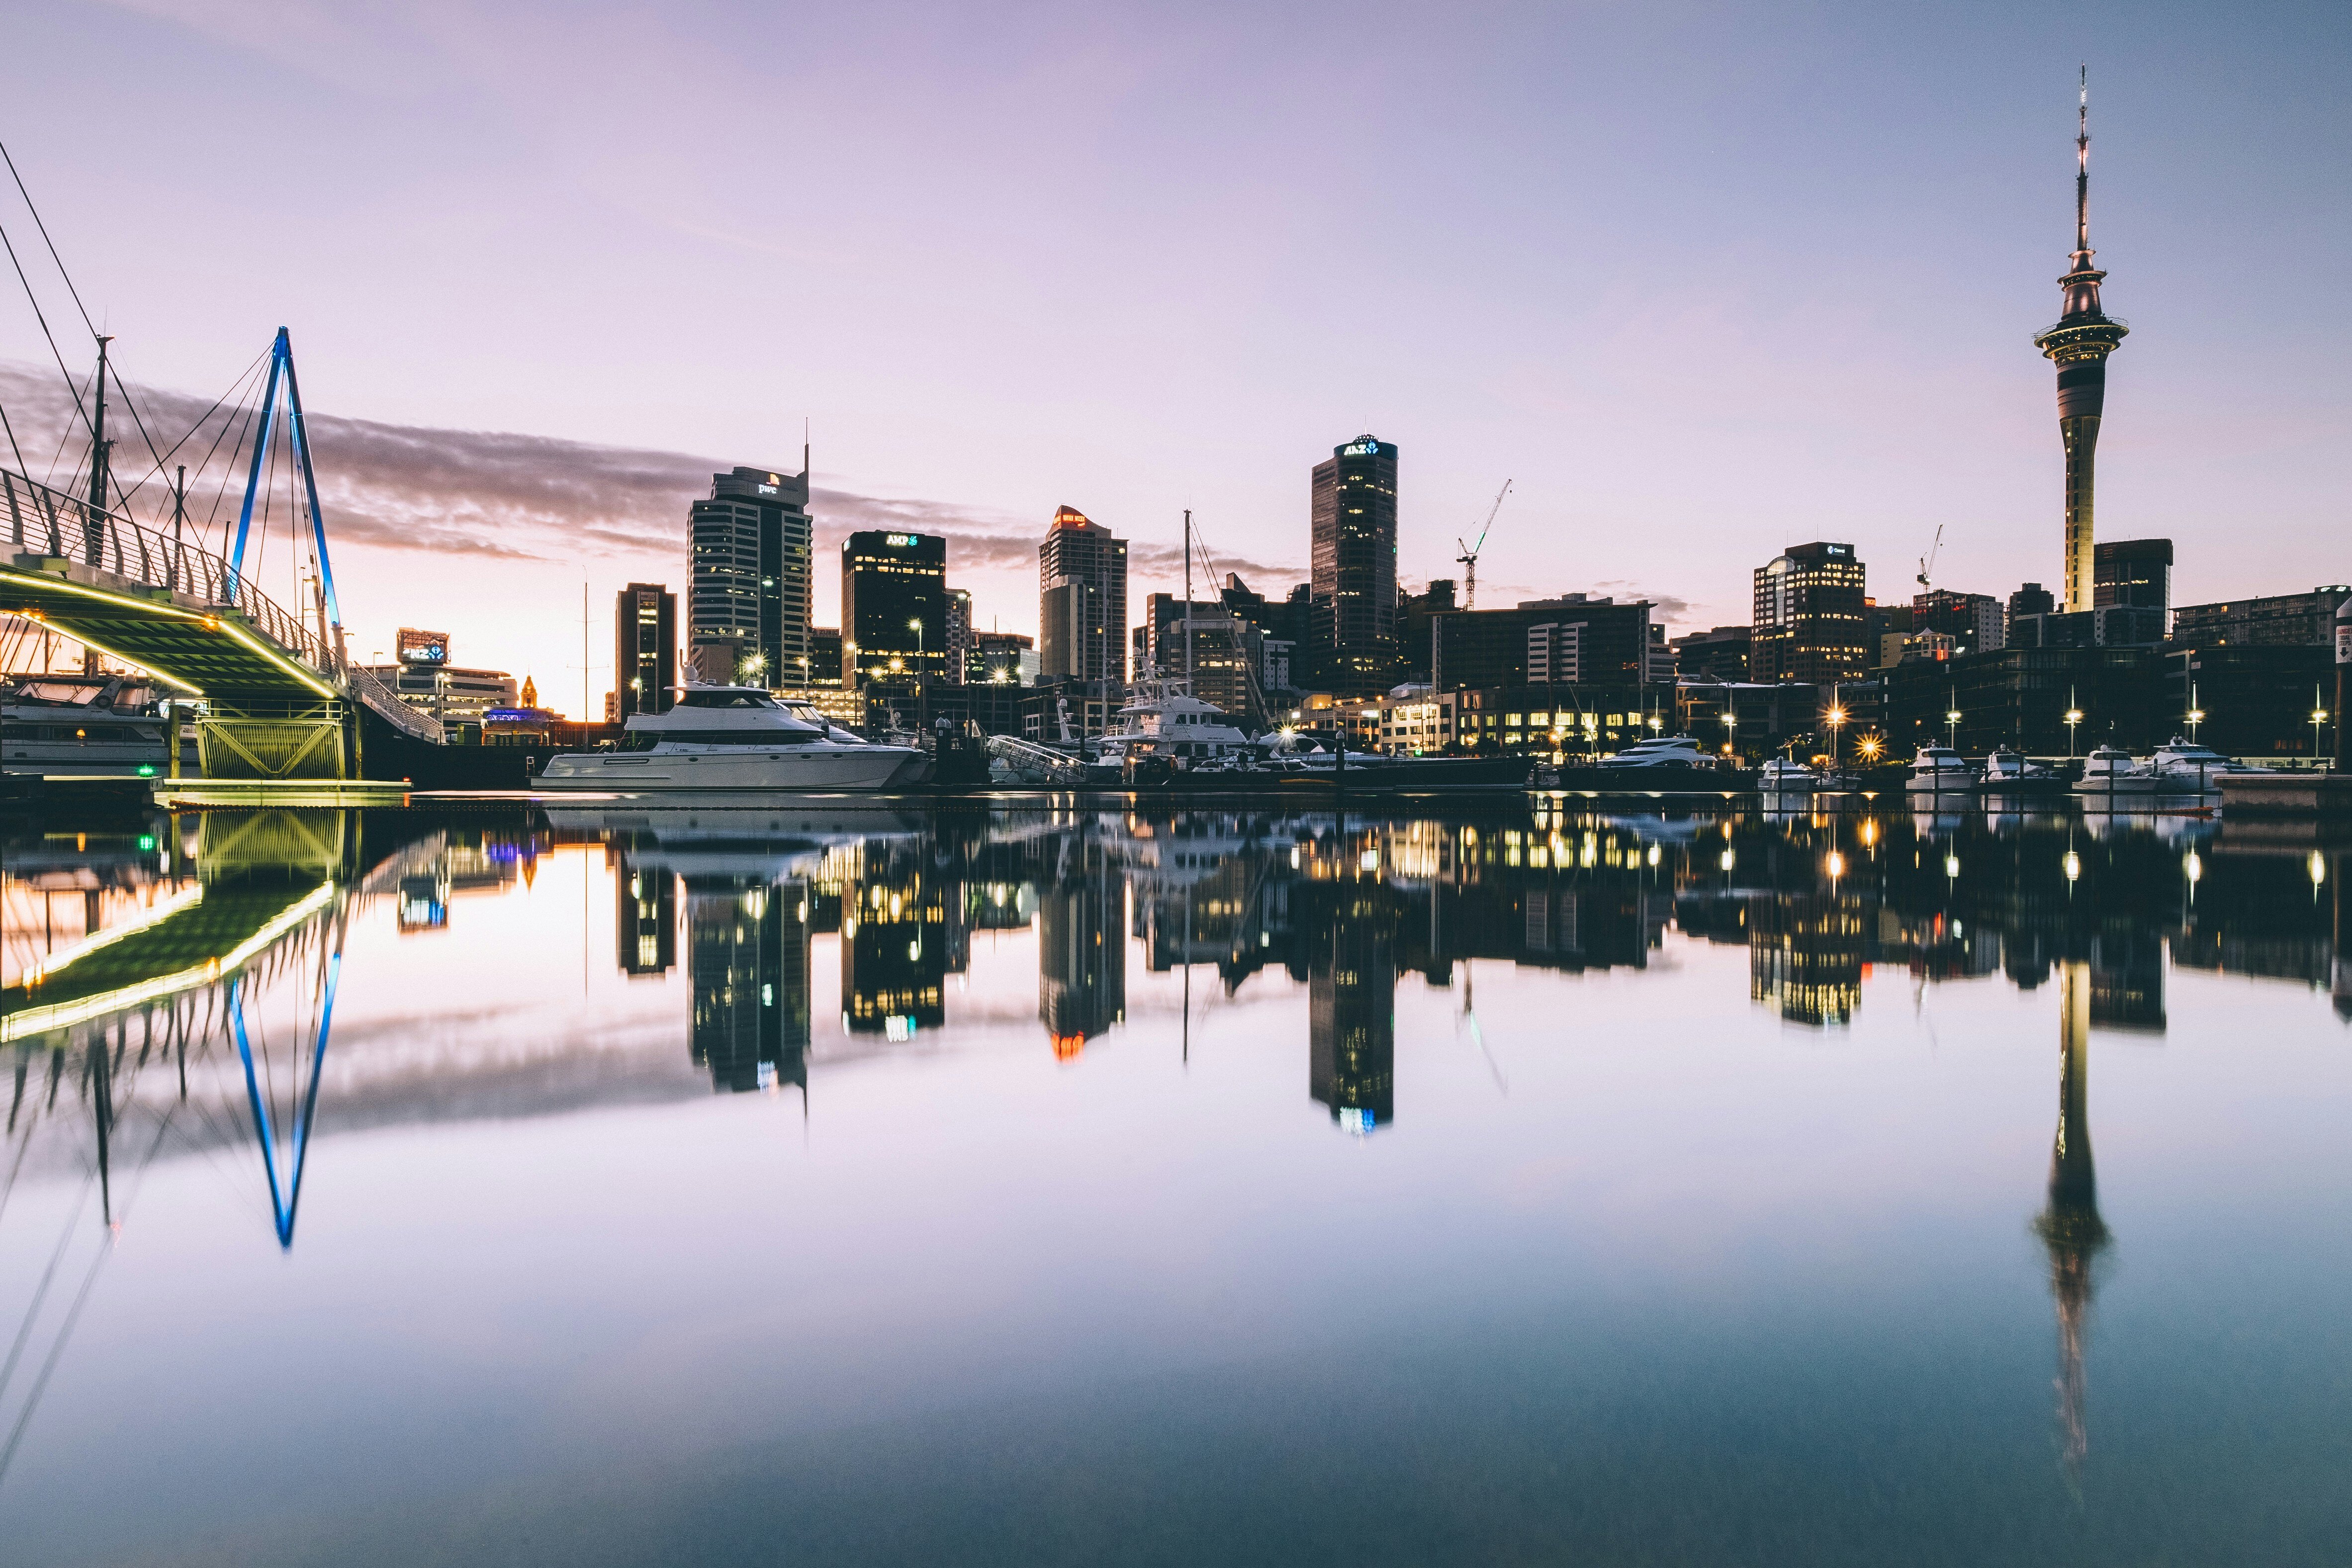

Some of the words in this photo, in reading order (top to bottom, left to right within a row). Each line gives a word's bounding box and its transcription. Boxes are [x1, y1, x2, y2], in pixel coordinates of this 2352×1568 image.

[1344, 444, 1366, 456] ANZ
[758, 484, 777, 494] pwc
[887, 535, 908, 546] AMP
